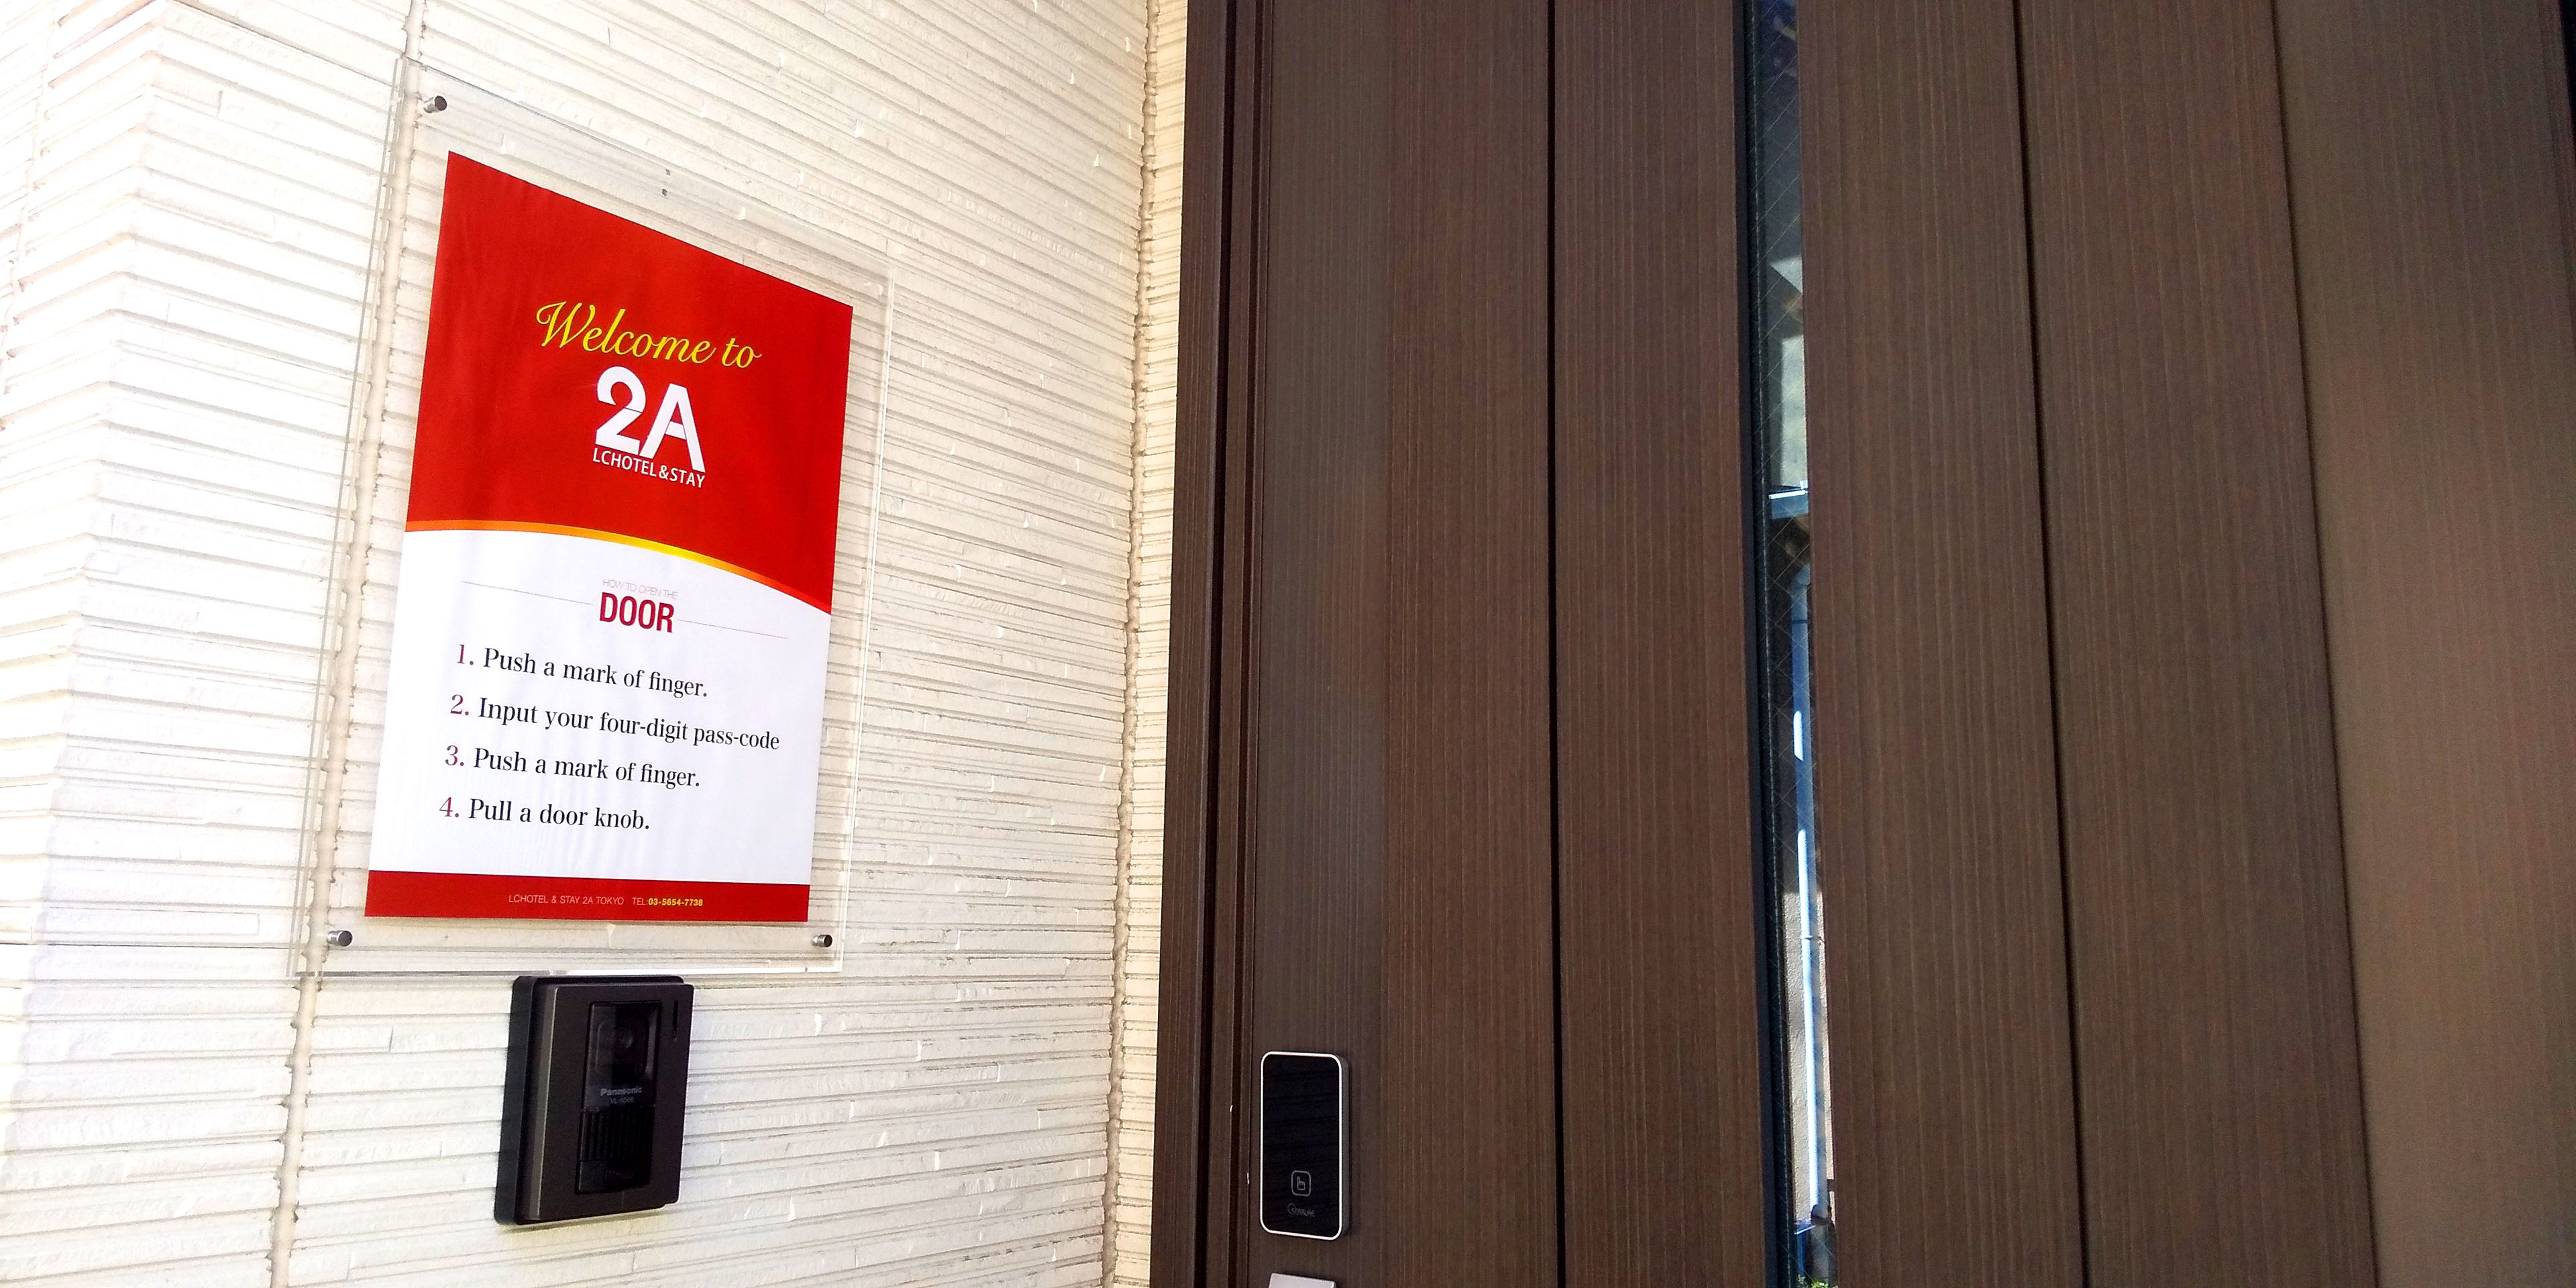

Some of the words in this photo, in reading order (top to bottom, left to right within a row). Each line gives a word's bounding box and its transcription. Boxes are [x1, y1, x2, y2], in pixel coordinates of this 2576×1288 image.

[536, 301, 716, 364] Welcome
[721, 337, 762, 368] to
[595, 366, 706, 473] 2A
[592, 447, 705, 488] LCHOTEL&STAY
[602, 578, 624, 589] HOW
[625, 582, 637, 592] TO
[639, 585, 661, 597] OPEN
[663, 589, 678, 600] THE
[599, 592, 675, 633] DOOR
[457, 644, 474, 665] 1.
[482, 647, 536, 674] Push
[543, 661, 555, 676] a
[563, 665, 617, 685] mark
[624, 669, 644, 688] of
[649, 672, 708, 698] finger.
[450, 694, 470, 716] 2.
[478, 697, 538, 726] Input
[545, 710, 594, 730] your
[600, 712, 688, 743] four-digit
[693, 727, 780, 750] pass-code
[445, 745, 465, 767] 3.
[474, 747, 527, 772] Push
[535, 759, 547, 773] a
[554, 759, 608, 779] mark
[615, 763, 636, 781] of
[640, 764, 700, 790] finger.
[439, 797, 460, 818] 4.
[468, 798, 511, 821] Pull
[520, 808, 531, 822] a
[539, 804, 588, 825] door
[594, 807, 650, 830] knob.
[508, 894, 548, 904] LCHOTEL
[551, 896, 557, 904] &
[559, 895, 580, 904] STAY
[582, 896, 593, 904] 2A
[596, 896, 625, 906] TOKYO
[600, 1086, 642, 1095] Panasonic
